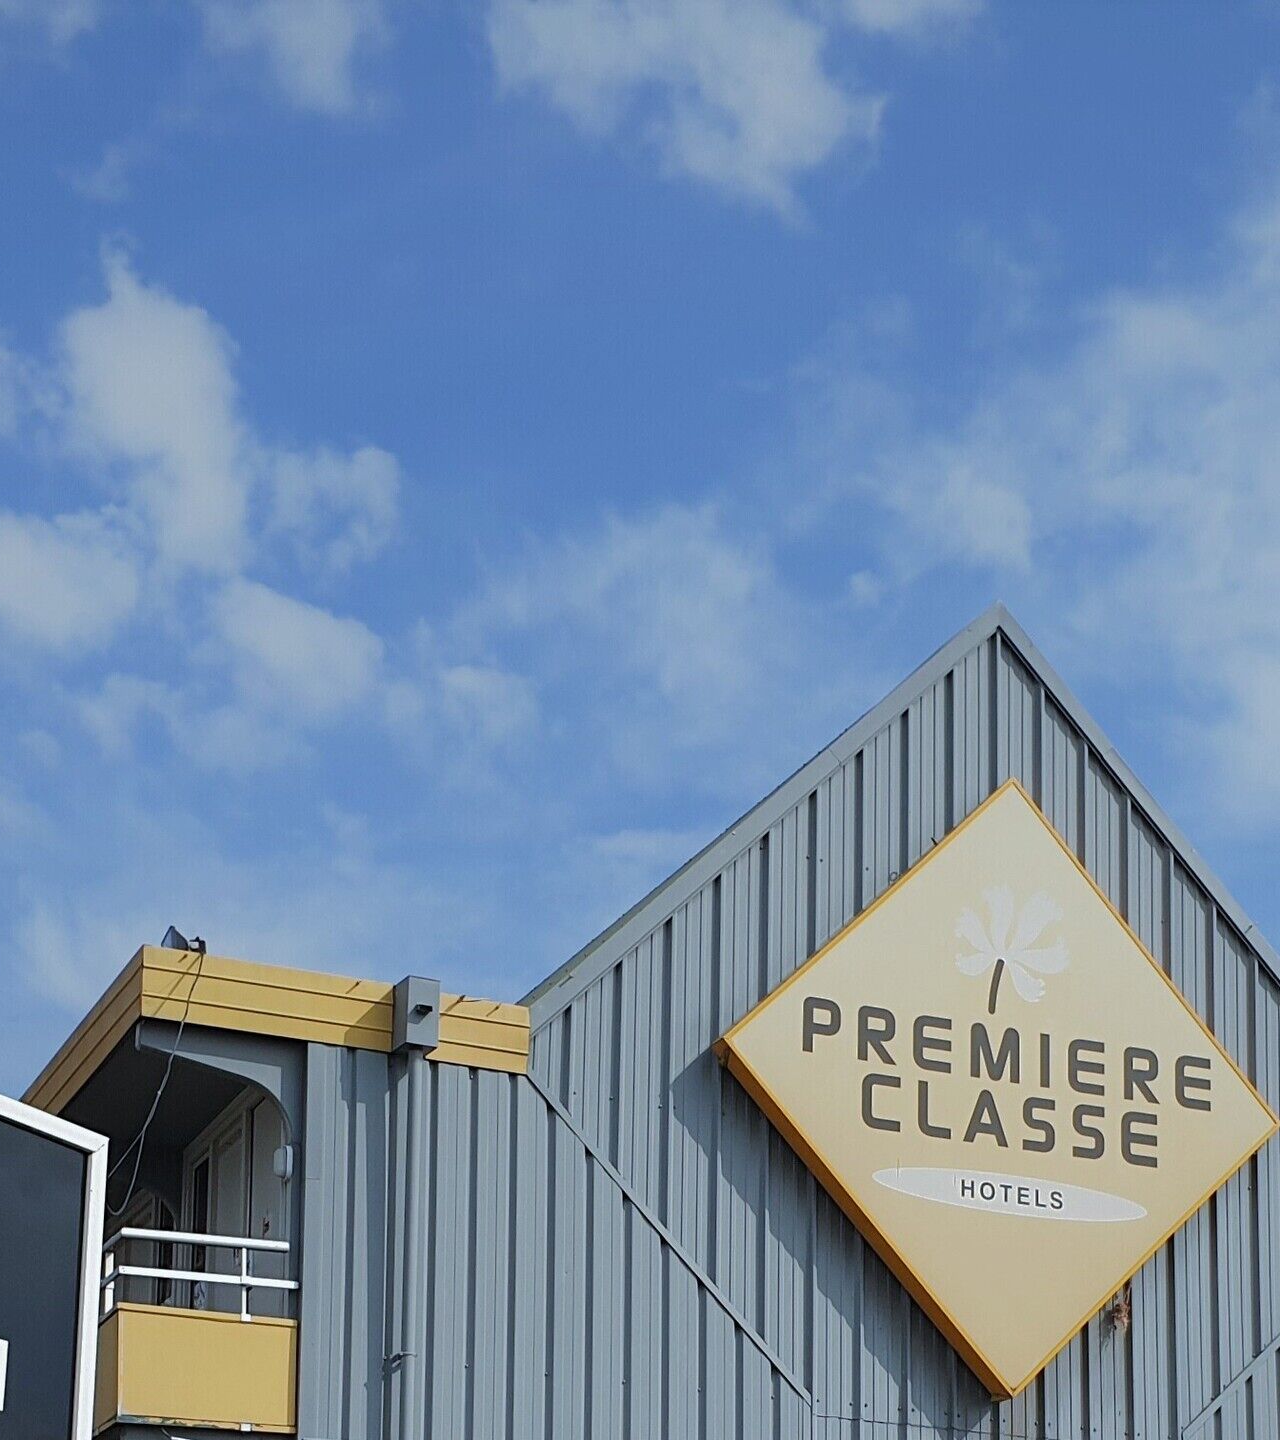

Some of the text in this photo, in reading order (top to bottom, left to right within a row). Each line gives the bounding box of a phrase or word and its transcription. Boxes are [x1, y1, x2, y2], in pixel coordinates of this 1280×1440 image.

[802, 997, 1211, 1111] PREMIERE
[861, 1073, 1158, 1168] CLASSE
[960, 1178, 1064, 1210] HOTELS
